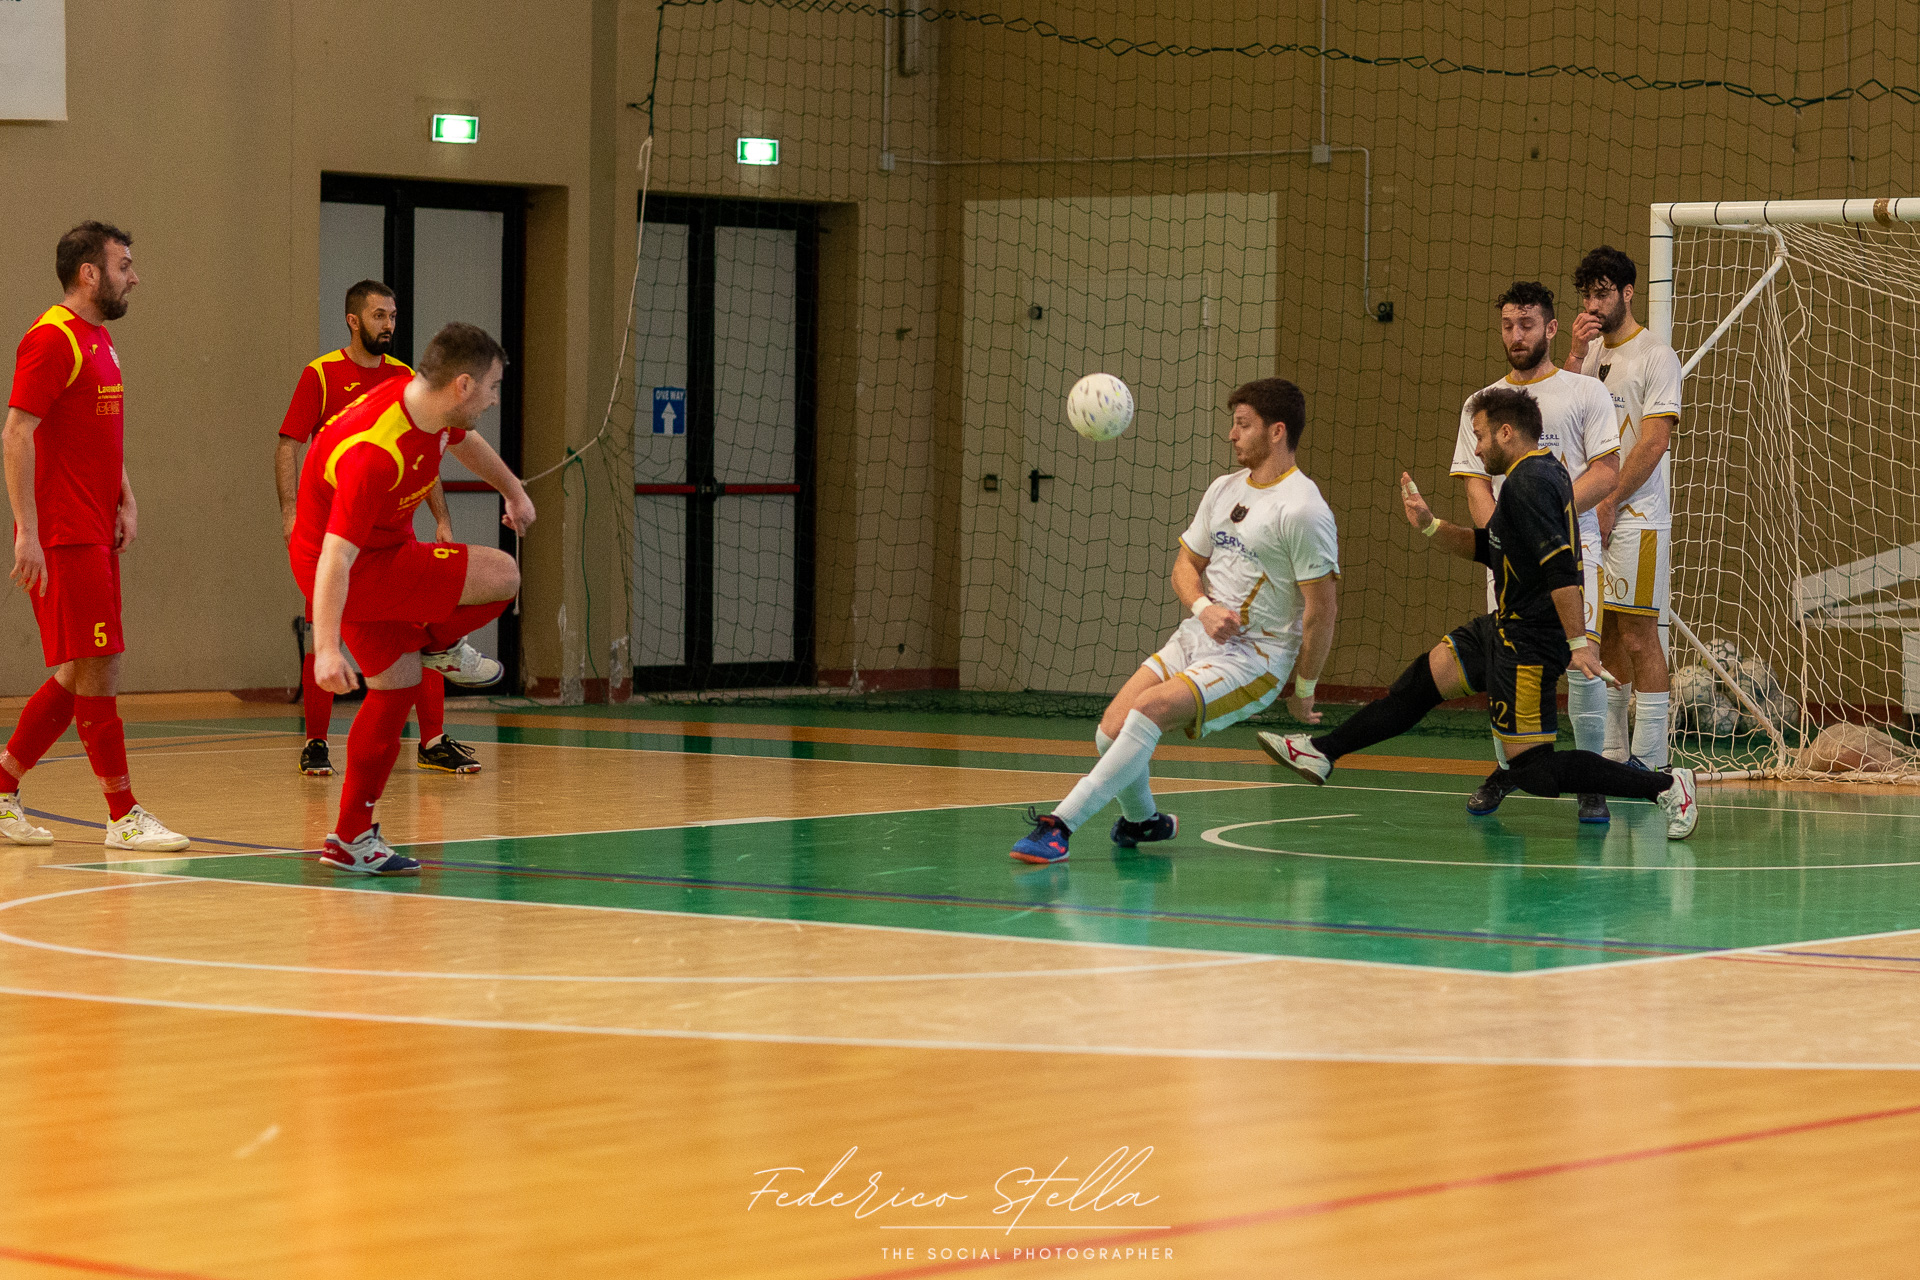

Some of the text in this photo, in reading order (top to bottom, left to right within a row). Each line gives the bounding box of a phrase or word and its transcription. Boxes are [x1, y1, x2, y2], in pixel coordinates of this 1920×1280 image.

[655, 389, 684, 400] ONE WAY
[433, 548, 459, 559] 9
[1604, 573, 1629, 600] 80
[94, 622, 107, 647] 5
